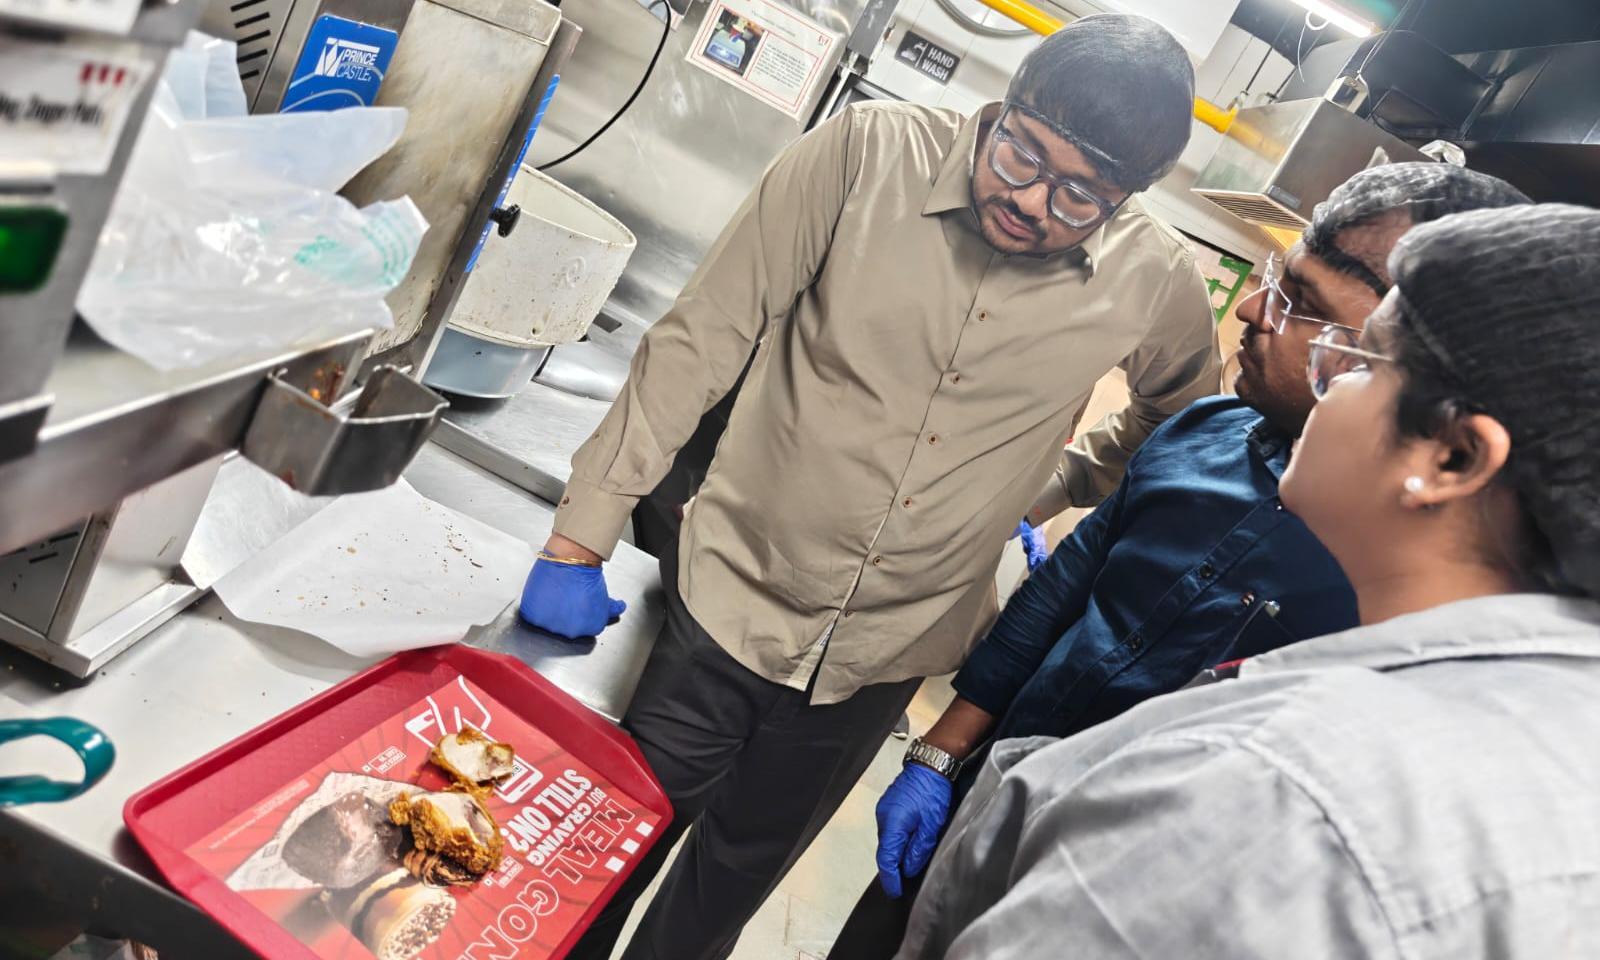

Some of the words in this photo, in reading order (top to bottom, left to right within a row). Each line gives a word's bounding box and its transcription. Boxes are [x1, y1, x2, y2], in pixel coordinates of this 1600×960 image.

[337, 63, 371, 81] CASTLE
[343, 48, 378, 66] PRINCE
[921, 58, 950, 81] WASH
[927, 46, 955, 69] HAND
[533, 768, 592, 818] STILL
[588, 786, 607, 808] BUT
[500, 806, 552, 852] ON?
[526, 802, 592, 866] CRAVING
[542, 798, 636, 885] MEAL
[456, 879, 560, 960] GON
